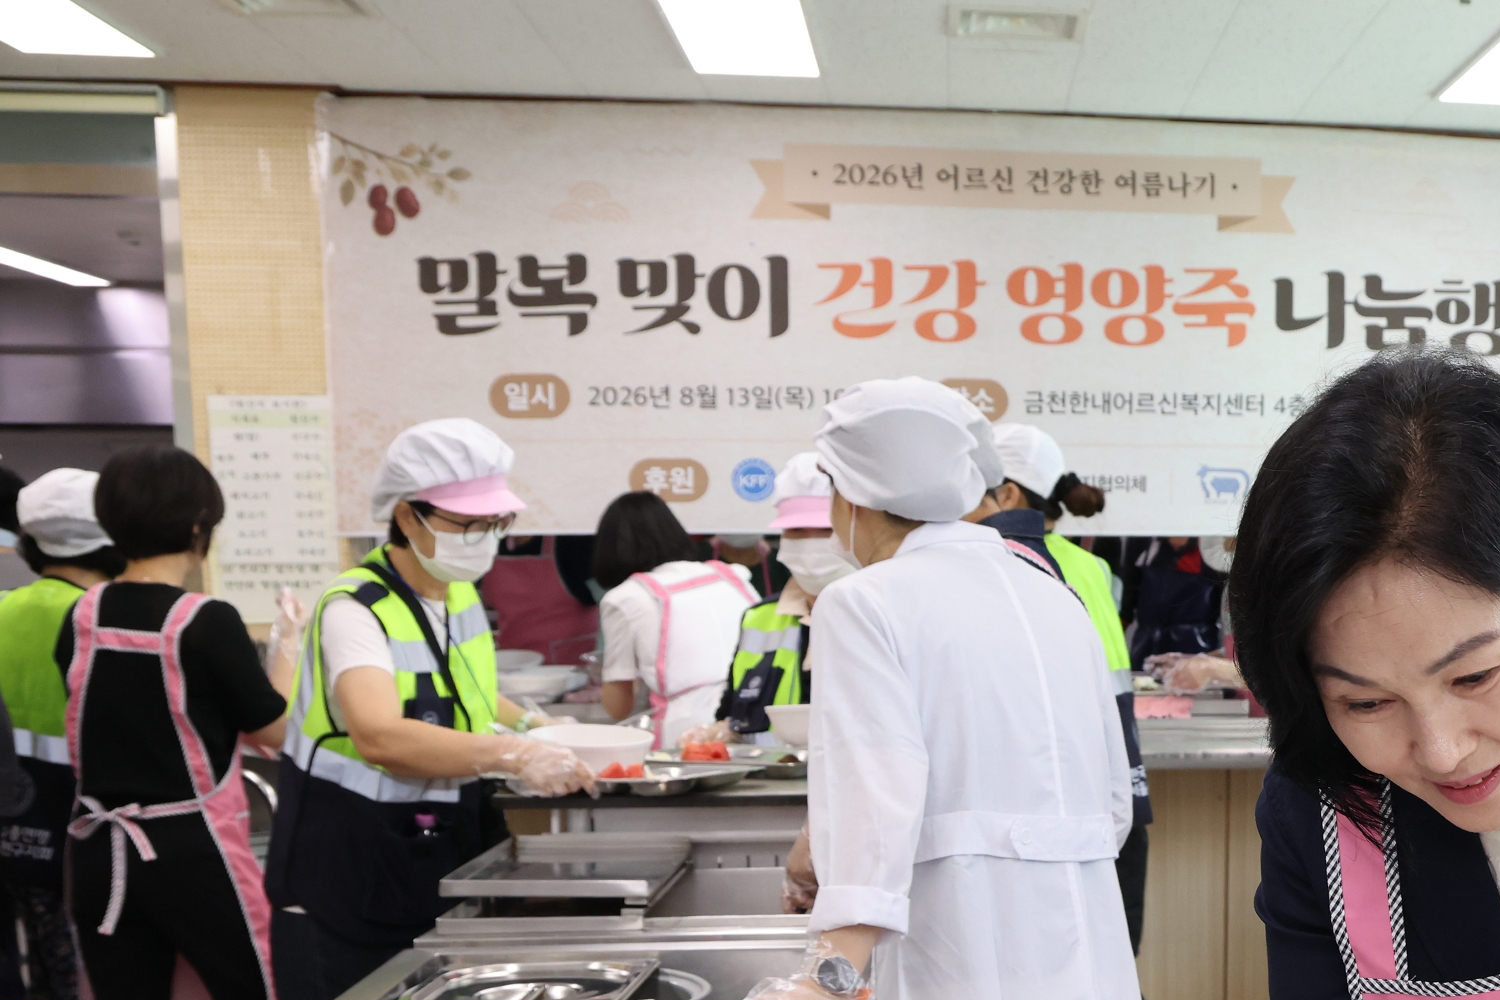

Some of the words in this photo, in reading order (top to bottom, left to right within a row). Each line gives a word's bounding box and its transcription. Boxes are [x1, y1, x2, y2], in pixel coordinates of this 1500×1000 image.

[832, 163, 924, 190] 2026년
[936, 164, 1014, 194] 어르신
[1027, 167, 1103, 196] 건강한
[1115, 170, 1217, 199] 여름나기
[414, 251, 598, 337] 말복
[615, 253, 790, 338] 맞이
[813, 257, 986, 343] 건강
[1006, 262, 1256, 347] 영양죽
[503, 381, 555, 412] 일시
[587, 385, 670, 409] 2026년
[680, 385, 717, 410] 8월
[727, 386, 814, 411] 13일(목)
[1024, 390, 1265, 416] 금천한내어르신복지센터
[643, 466, 695, 494] 후원
